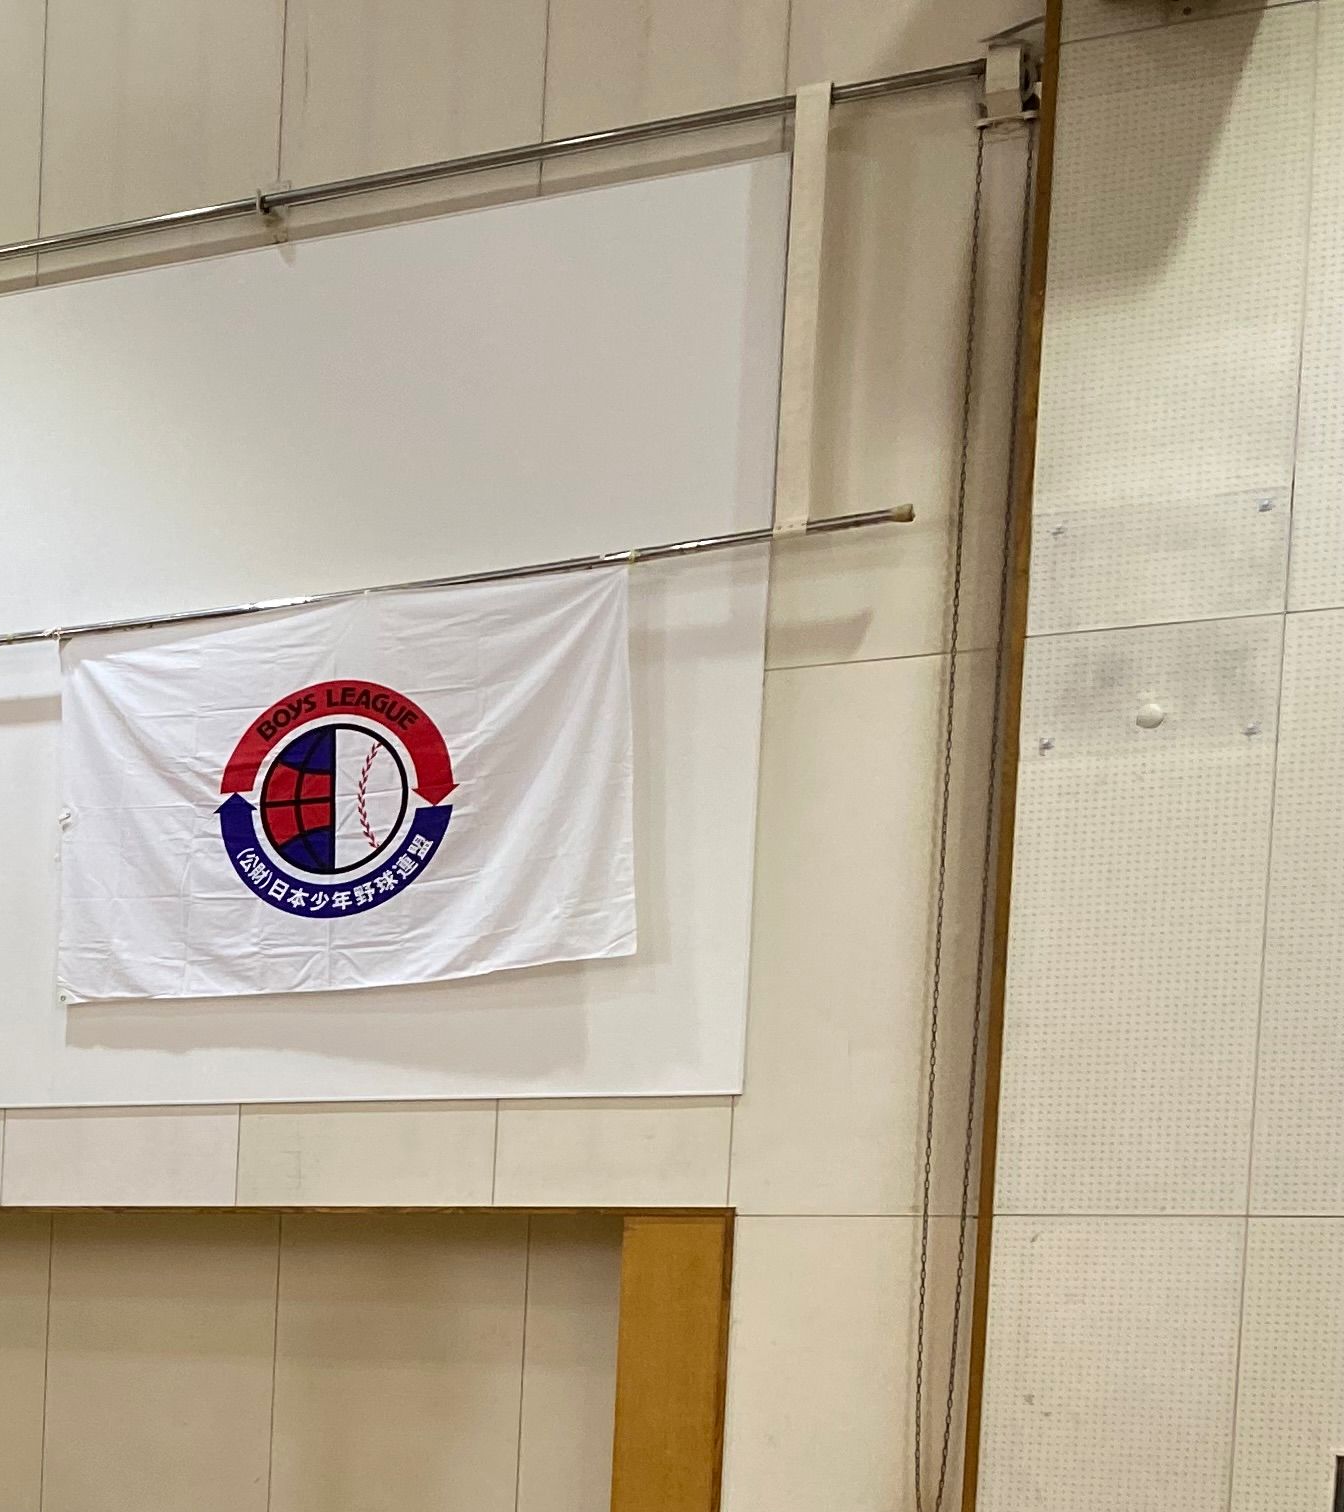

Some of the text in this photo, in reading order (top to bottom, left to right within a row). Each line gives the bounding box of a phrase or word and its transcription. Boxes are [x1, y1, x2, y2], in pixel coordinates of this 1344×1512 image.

[256, 687, 420, 742] BOYS LEAGUE
[236, 834, 435, 911] (公財)日本少年野球連盟
